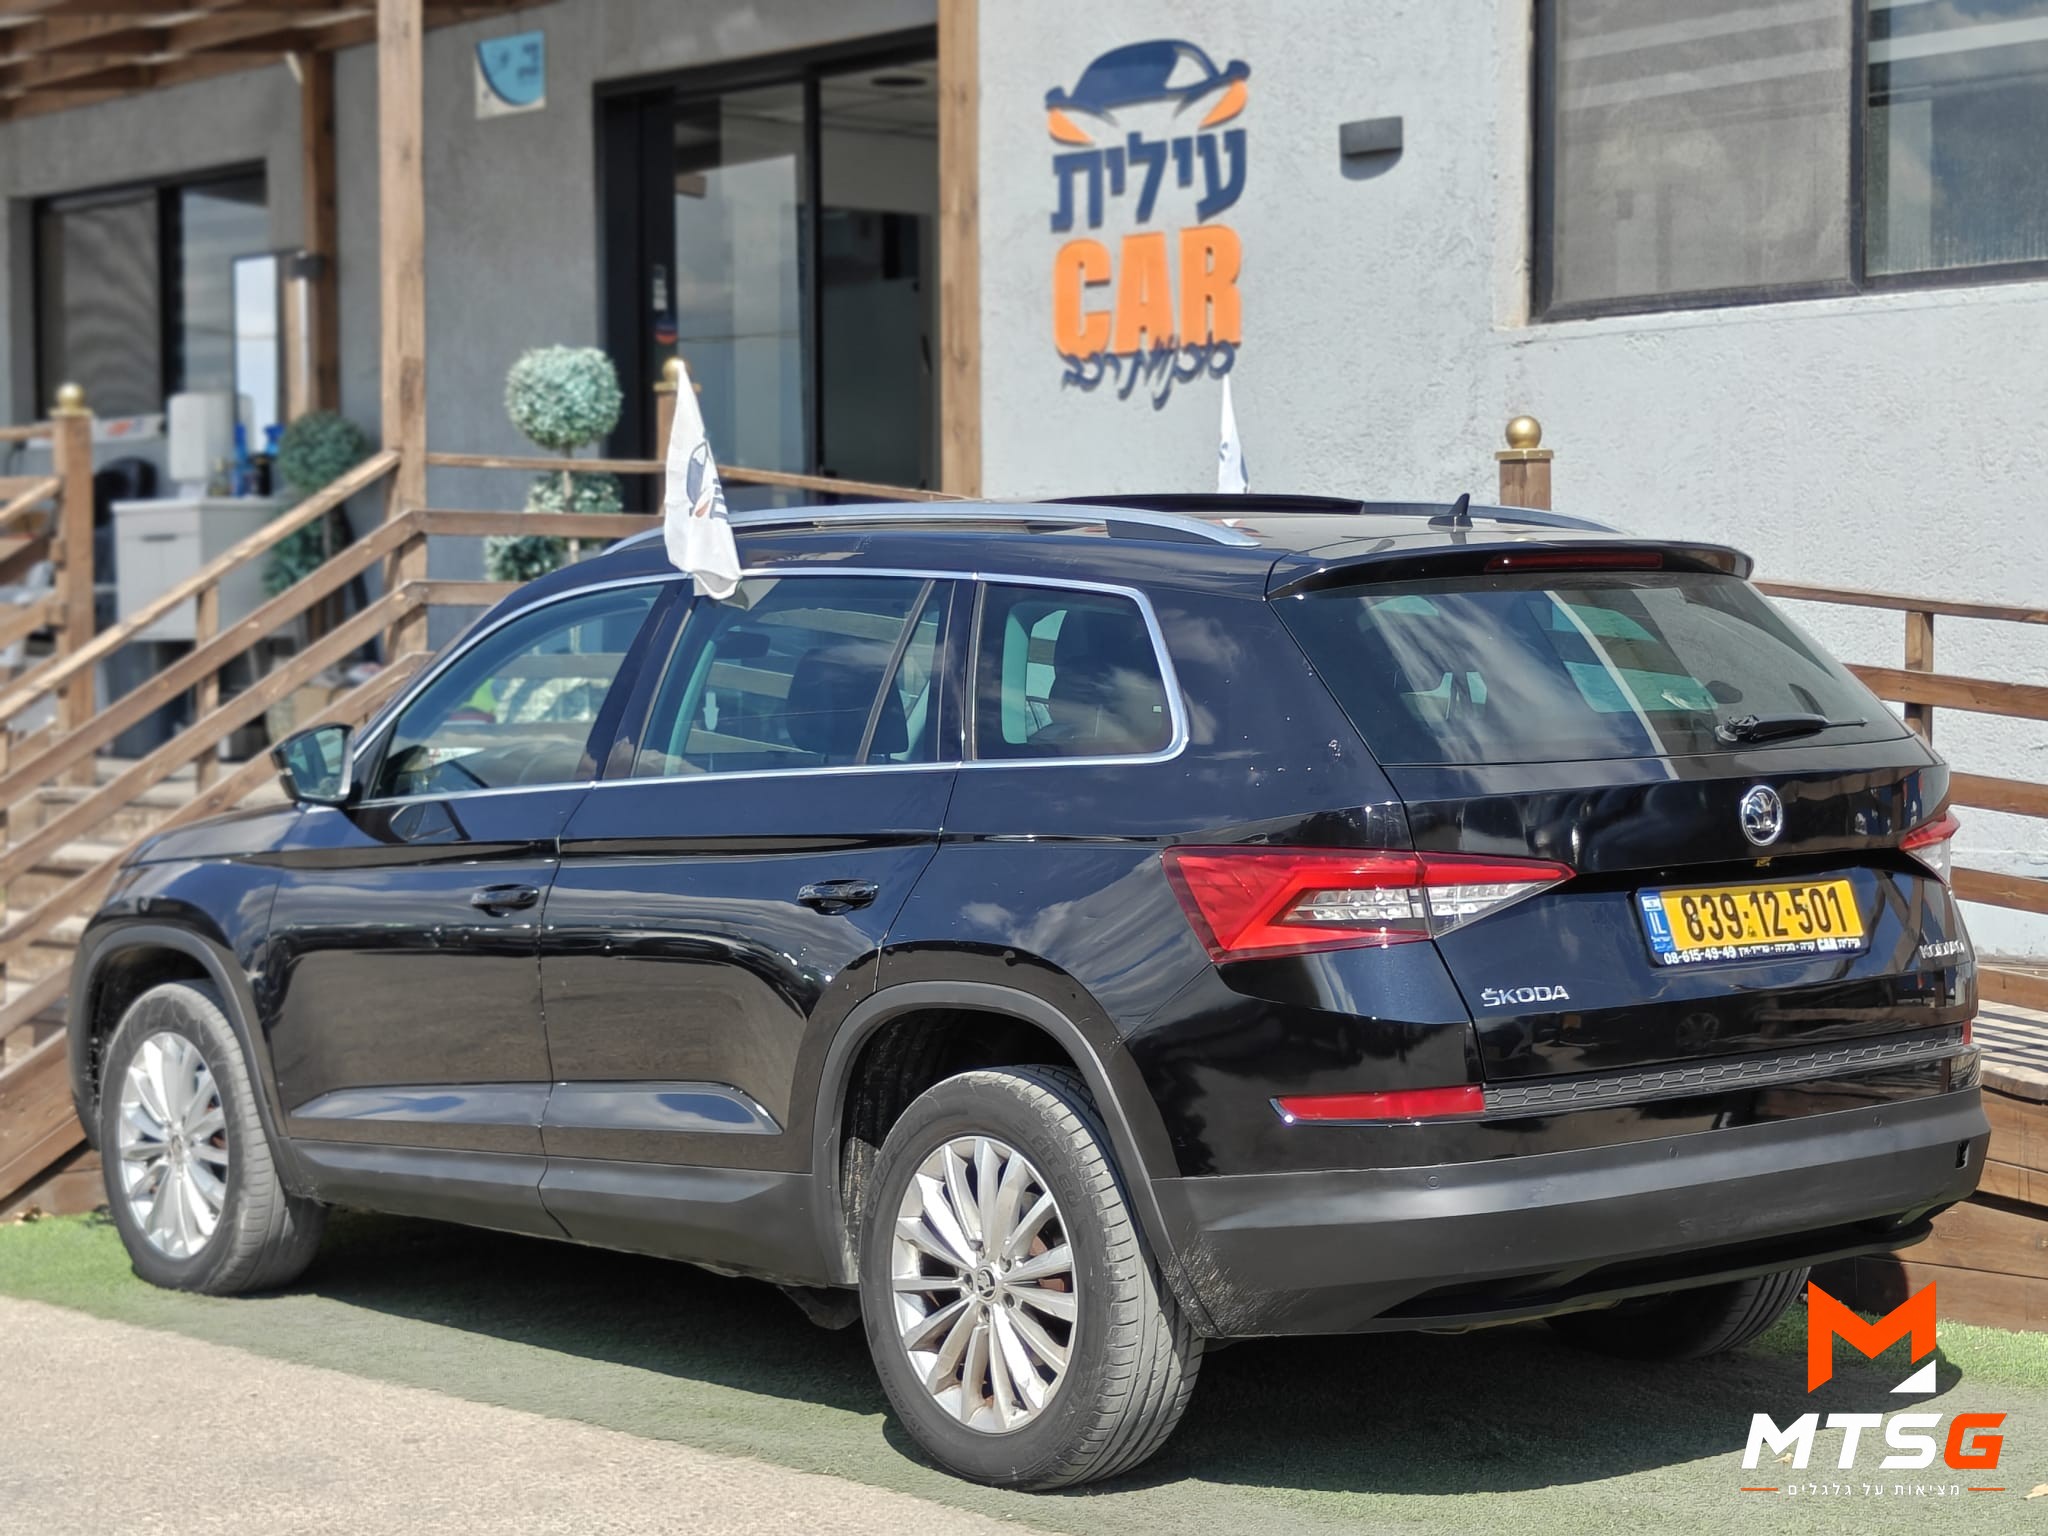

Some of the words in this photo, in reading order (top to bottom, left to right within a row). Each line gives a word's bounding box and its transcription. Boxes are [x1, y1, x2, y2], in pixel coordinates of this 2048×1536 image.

[1050, 128, 1247, 233] עילית
[1054, 224, 1242, 360] CAR
[1481, 985, 1570, 1007] ŠKODA
